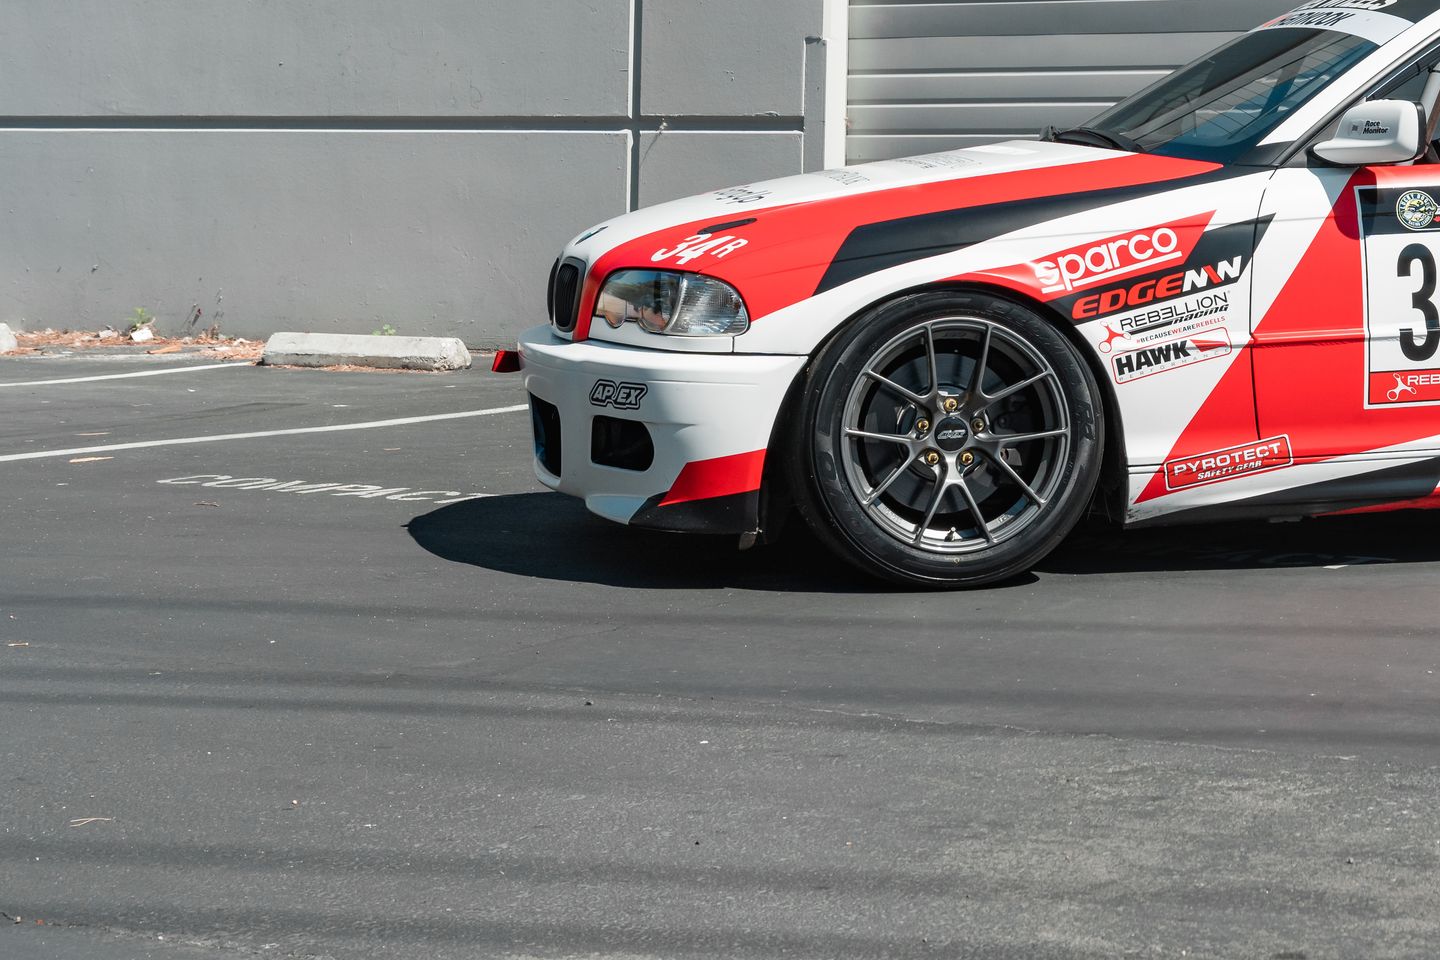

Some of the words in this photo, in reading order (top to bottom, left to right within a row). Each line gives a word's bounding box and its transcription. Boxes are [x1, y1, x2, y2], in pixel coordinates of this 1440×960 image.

[1034, 227, 1178, 291] sparco
[1119, 291, 1228, 331] REBELLION
[1115, 340, 1191, 376] HAWK
[592, 385, 642, 405] APEX
[1174, 442, 1281, 476] PYROTECT
[1197, 466, 1235, 480] SAFETY
[1235, 460, 1263, 472] GEAR
